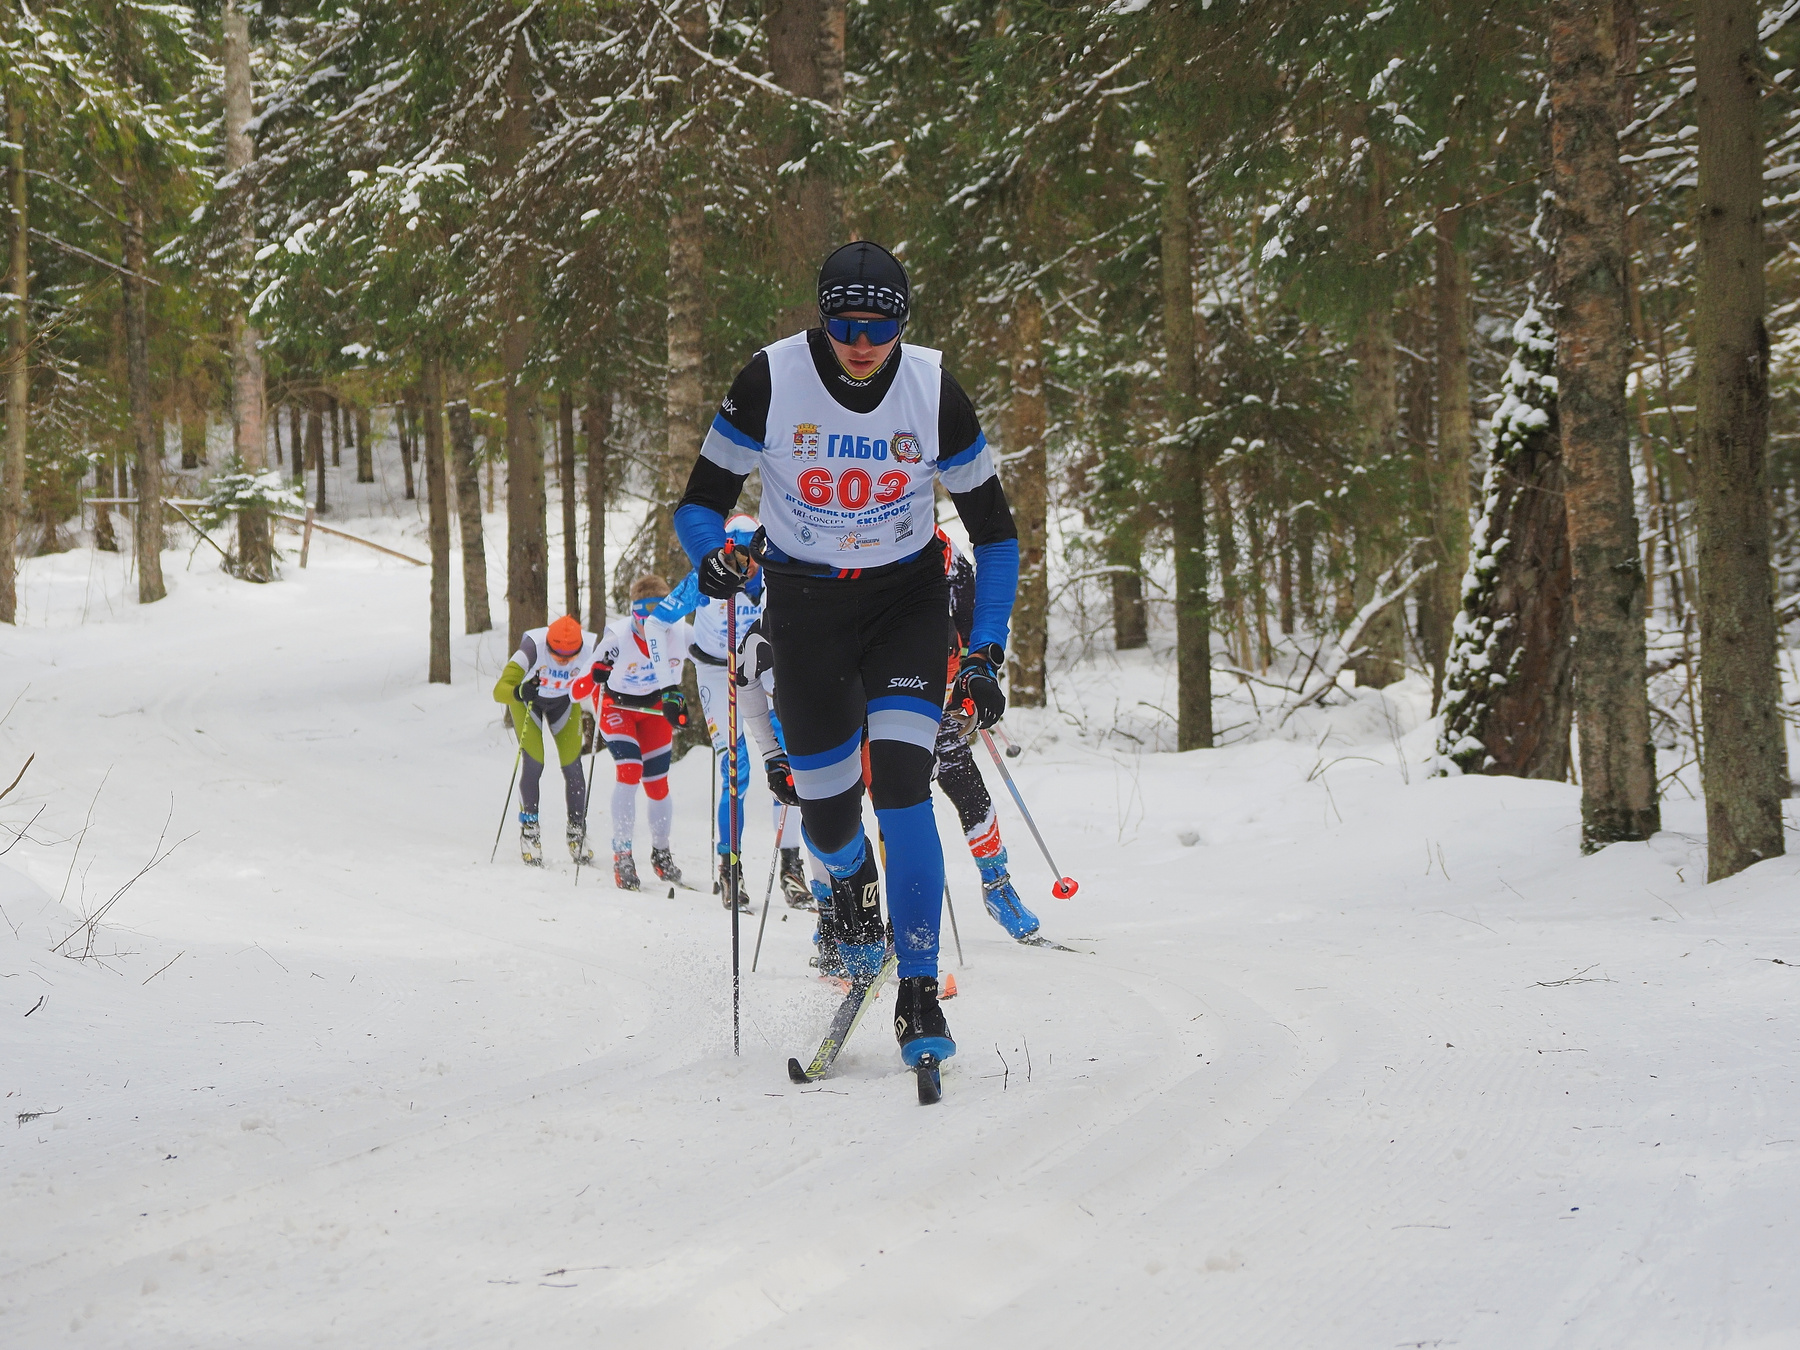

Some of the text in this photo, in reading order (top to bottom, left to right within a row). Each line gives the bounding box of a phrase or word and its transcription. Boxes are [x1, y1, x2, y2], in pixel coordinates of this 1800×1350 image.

[827, 434, 888, 461] ГАБО
[797, 467, 911, 511] 603
[649, 639, 660, 663] RUS
